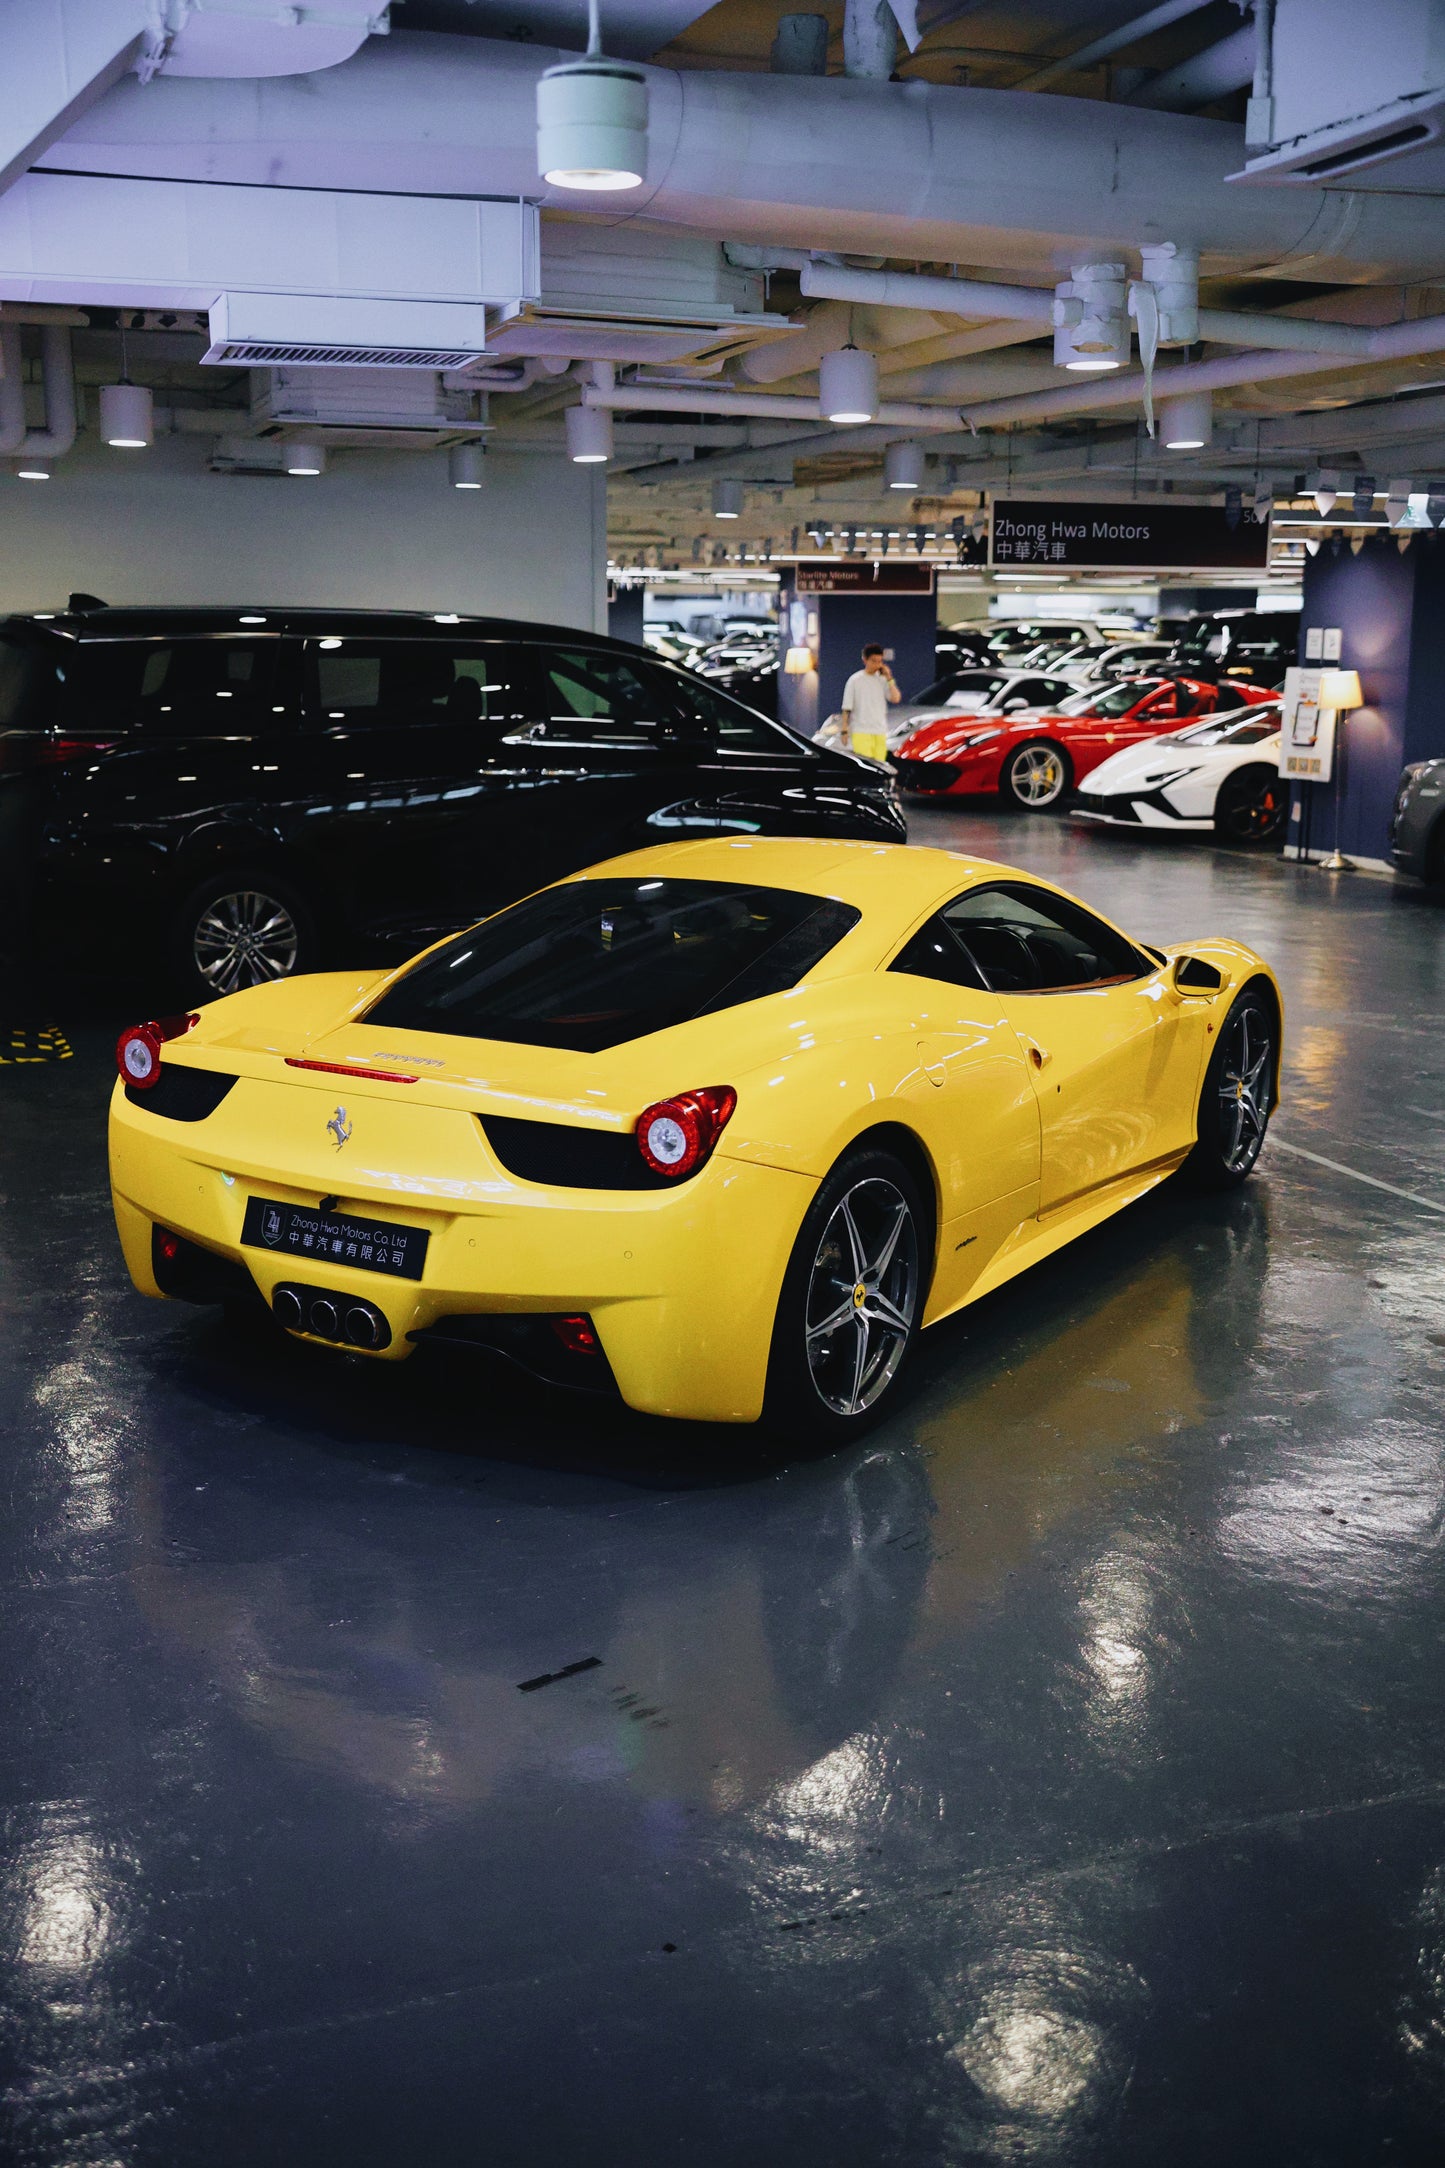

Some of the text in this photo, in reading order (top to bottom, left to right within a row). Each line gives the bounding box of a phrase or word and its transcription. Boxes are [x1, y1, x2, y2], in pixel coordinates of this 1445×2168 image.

[995, 519, 1150, 541] Zhong Hwa Motors
[996, 540, 1067, 561] 中華汽車
[829, 571, 859, 580] Motors
[290, 1214, 319, 1233] Zhong
[320, 1220, 339, 1235] Hwa
[340, 1224, 371, 1241] Motors
[288, 1230, 405, 1267] 中華汽車有限公司
